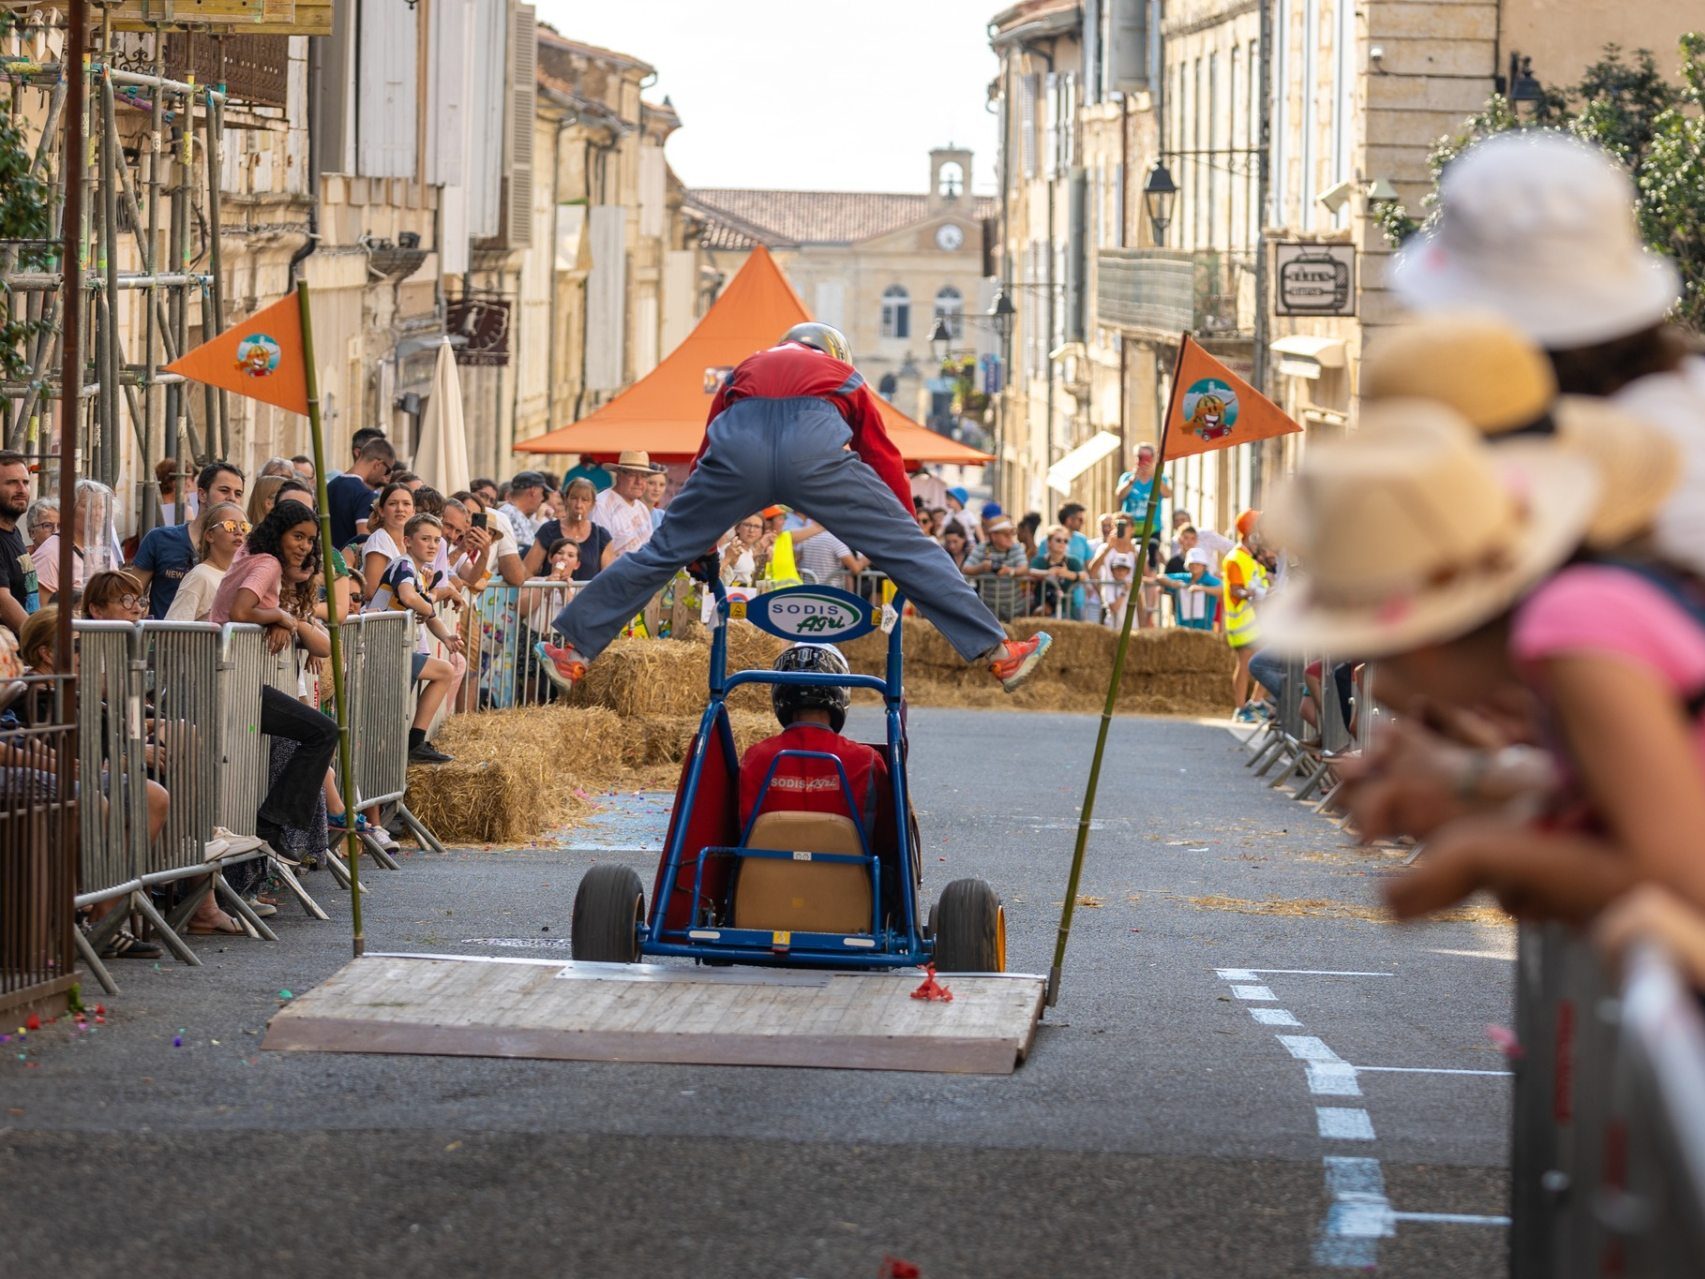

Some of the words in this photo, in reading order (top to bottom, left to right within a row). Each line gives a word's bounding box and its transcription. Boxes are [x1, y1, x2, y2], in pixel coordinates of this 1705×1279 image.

[772, 604, 839, 615] SODIS
[796, 615, 846, 633] Agri
[770, 777, 805, 789] SODIS
